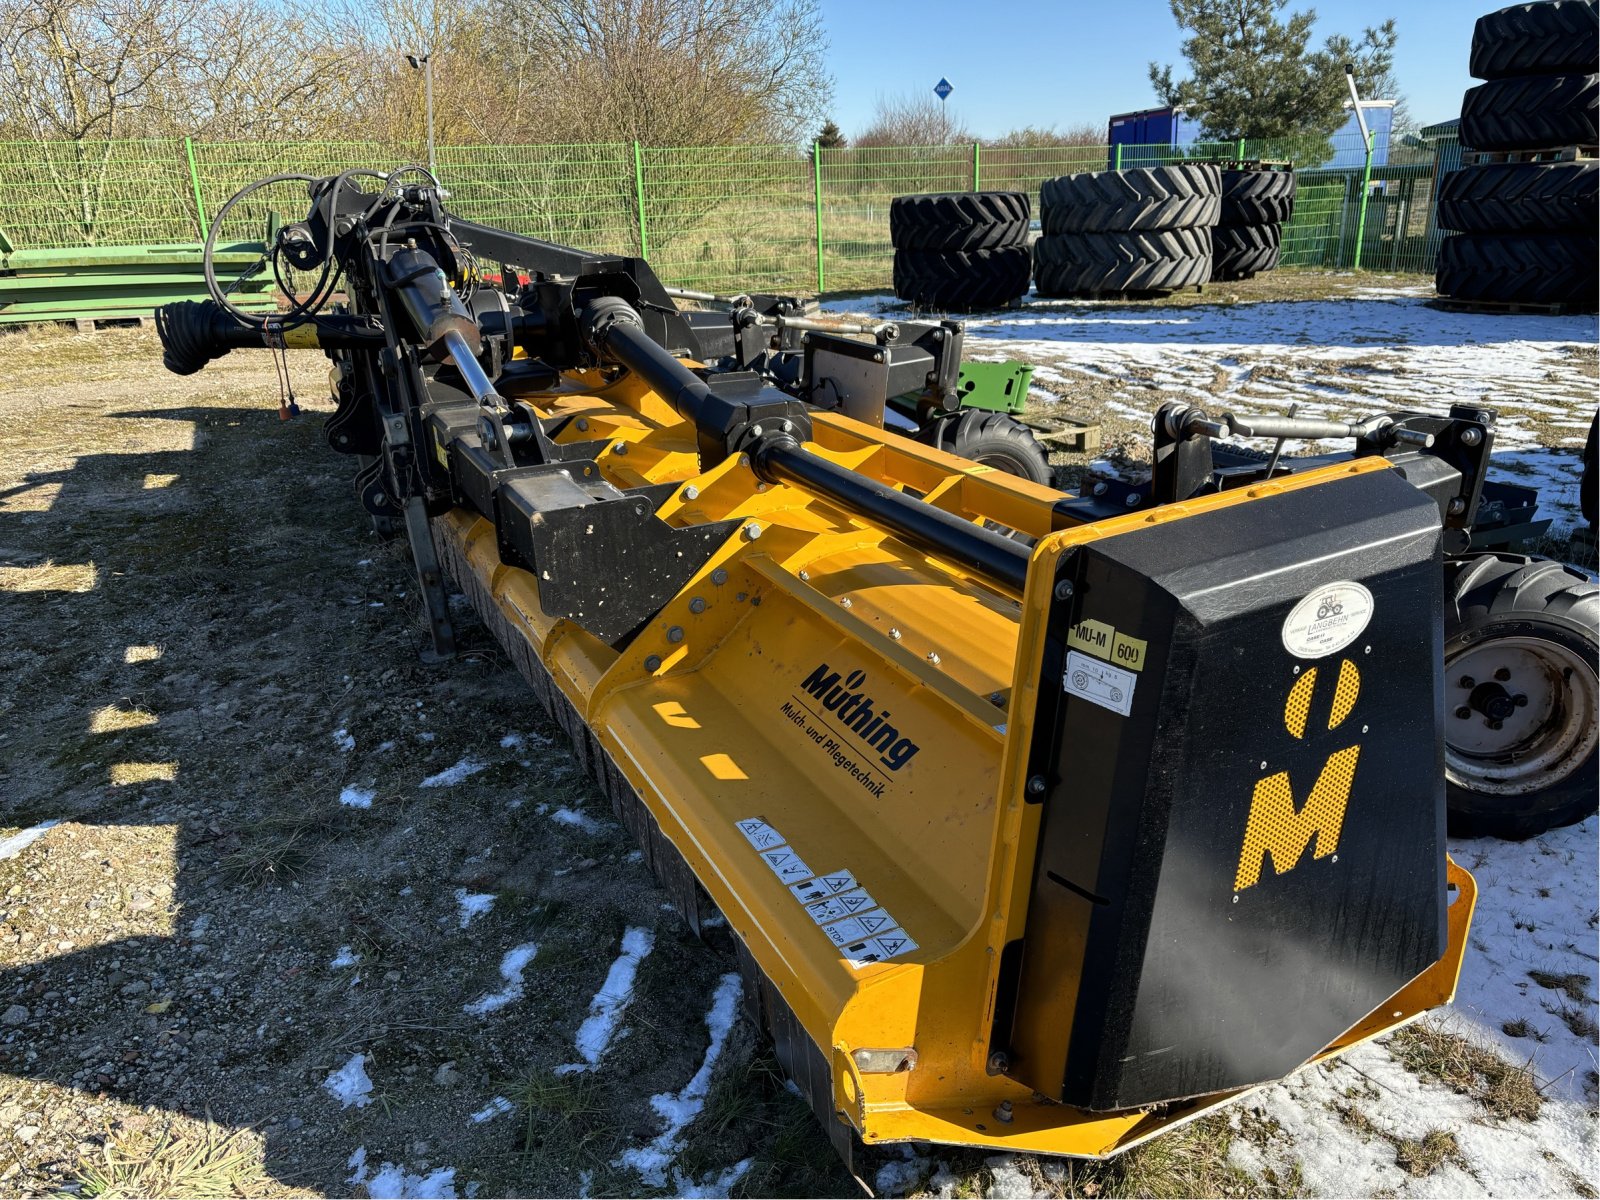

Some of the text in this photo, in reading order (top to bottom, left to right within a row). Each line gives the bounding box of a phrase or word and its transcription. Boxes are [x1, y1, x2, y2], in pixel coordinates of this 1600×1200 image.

[1307, 614, 1349, 635] LANGBEHN
[1075, 626, 1107, 647] MU-M
[1117, 643, 1139, 663] 600
[800, 663, 920, 771] Müthing
[780, 702, 885, 799] Mulch- und Pflegetechnik
[826, 926, 844, 945] STOP
